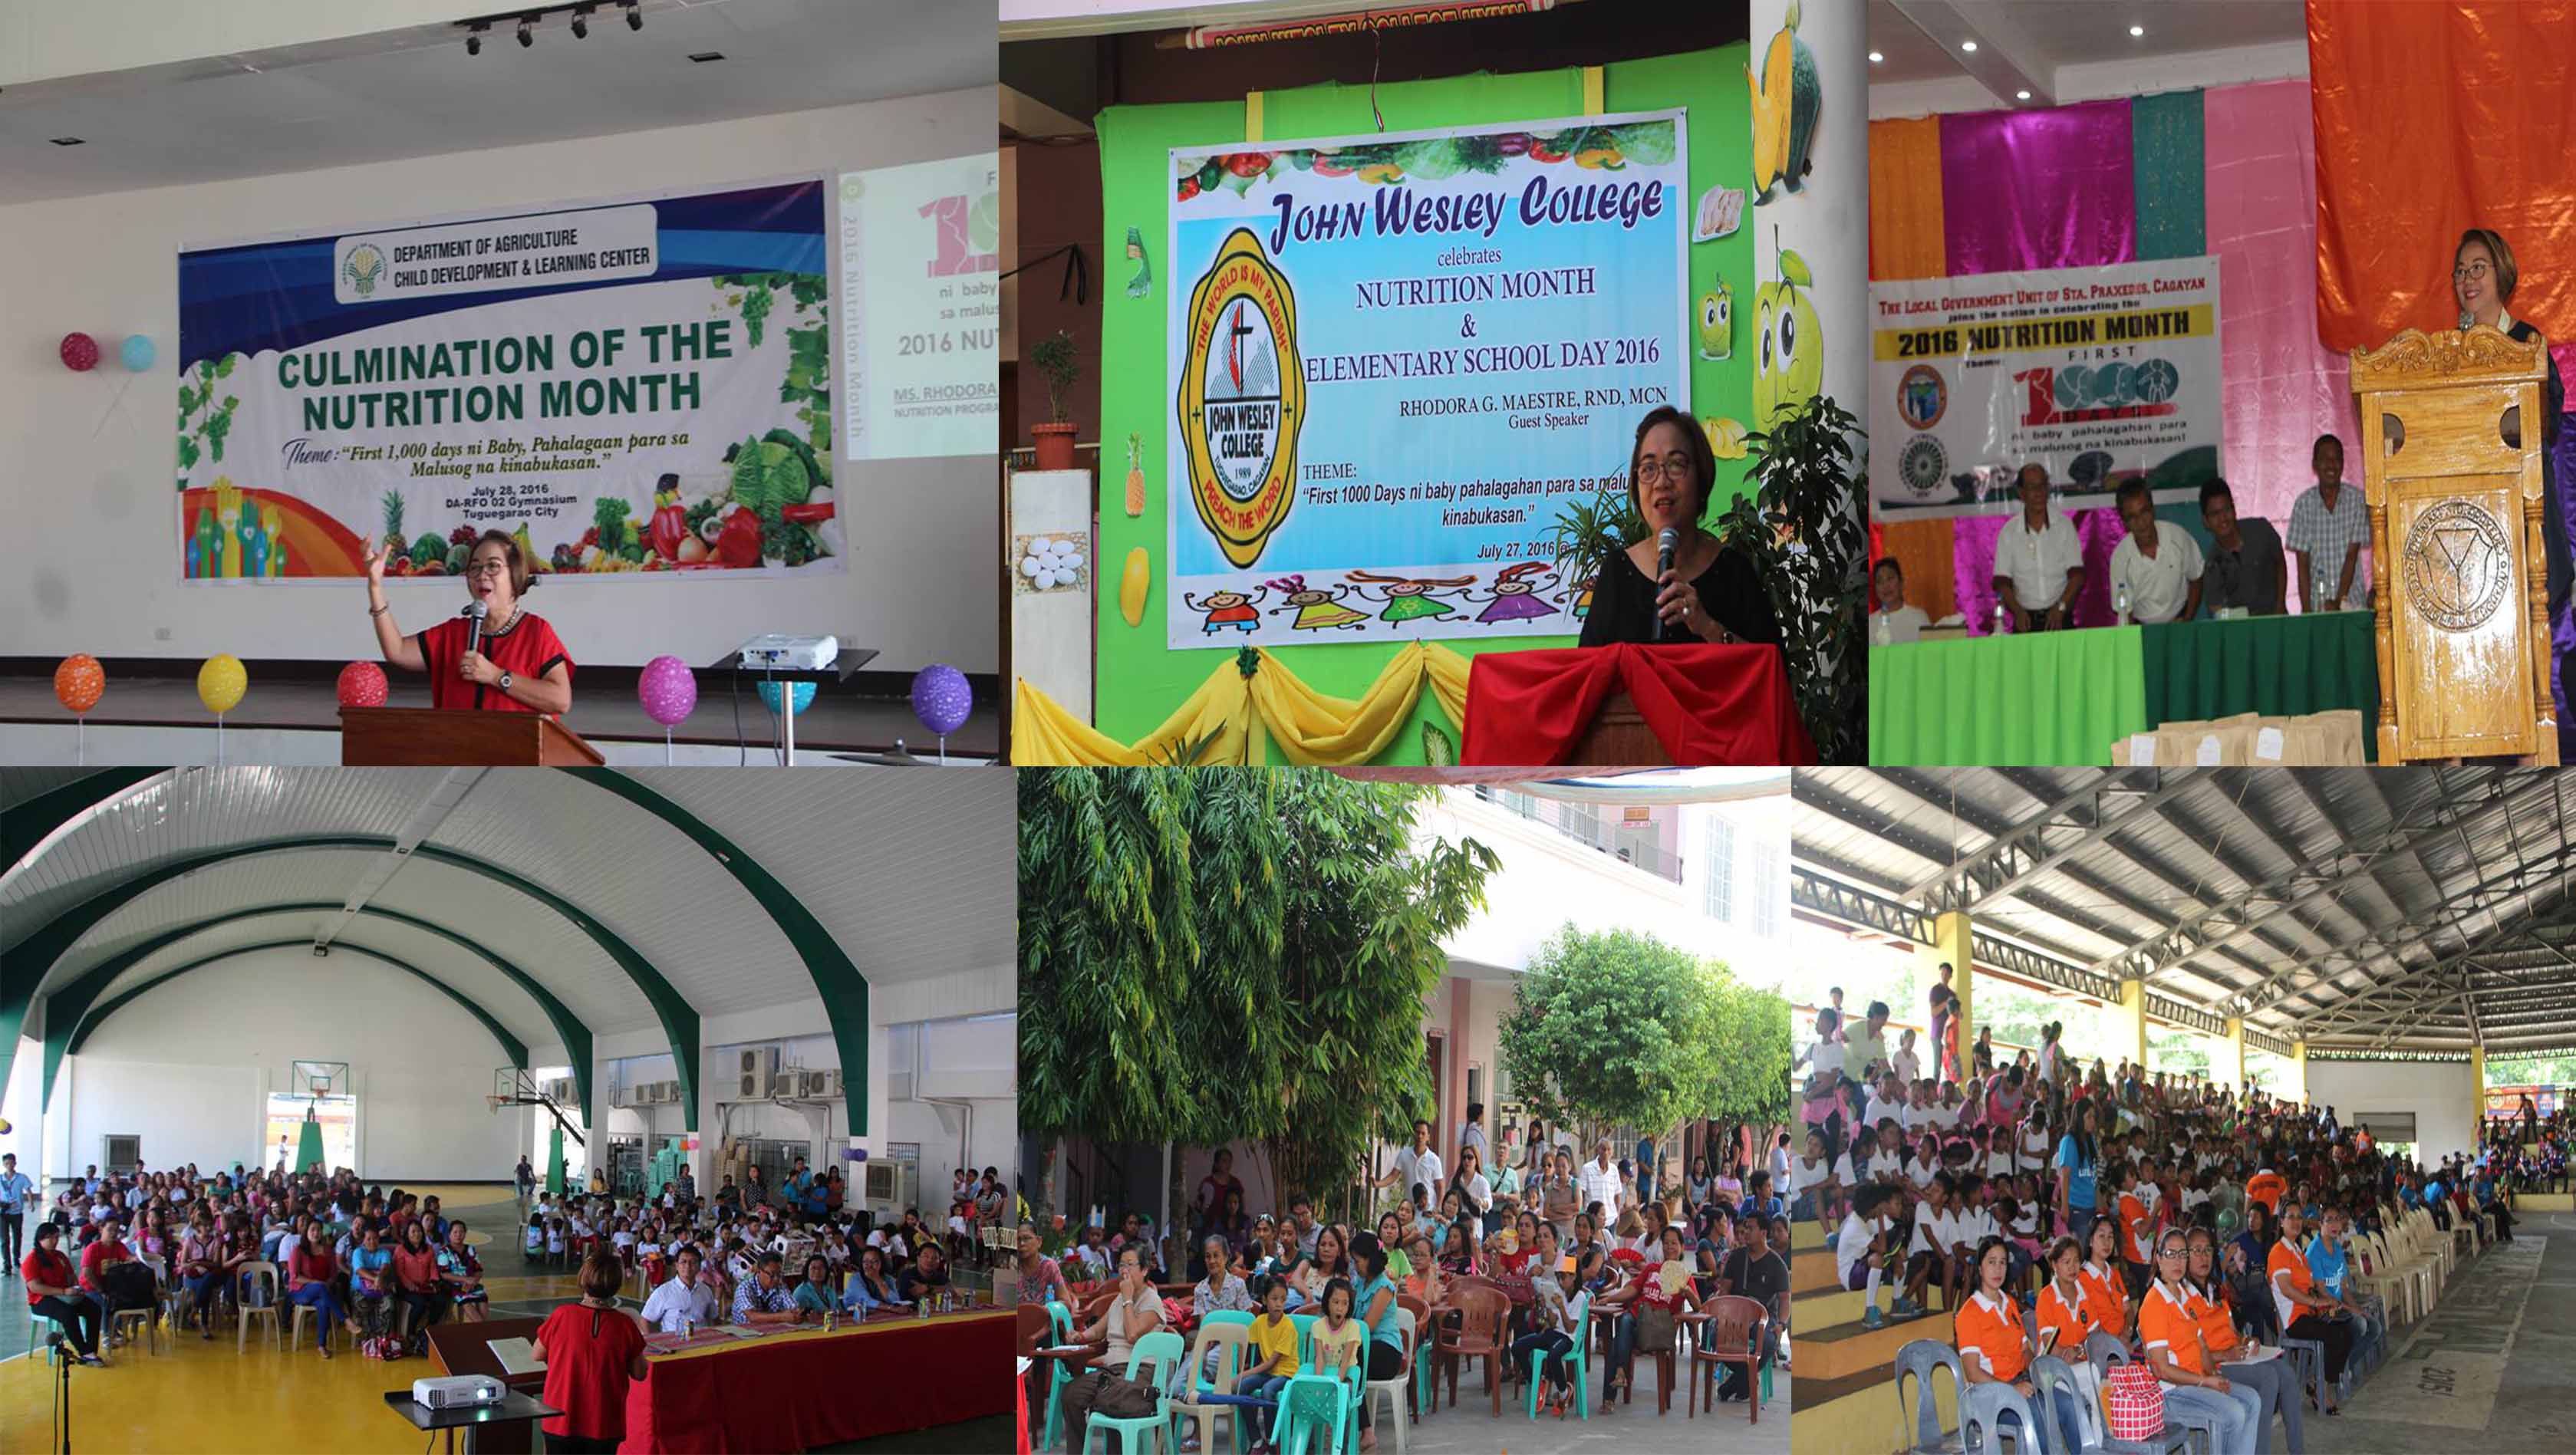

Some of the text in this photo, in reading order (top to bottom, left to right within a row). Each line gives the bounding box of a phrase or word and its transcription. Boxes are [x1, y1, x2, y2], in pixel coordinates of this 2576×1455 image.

[1270, 175, 1663, 255] JOHN WESLEY COLLEGE
[394, 229, 578, 264] DEPARTMENT OF AGRICULTURE
[1437, 246, 1501, 267] celebrates
[394, 247, 650, 288] CHILD DEVELOPMENT & LEARNING CENTER
[1207, 267, 1238, 315] WORLD
[1241, 265, 1248, 281] IS
[1251, 266, 1266, 292] MY
[1356, 268, 1596, 308] NUTRITION MONTH
[1905, 300, 1938, 314] LOCAL
[1942, 293, 2014, 311] GOVERNMENT
[2017, 290, 2042, 304] UNIT
[2153, 278, 2205, 294] CAGAYAN
[845, 216, 864, 438] 2016 Nutrition Month
[1461, 314, 1477, 337] &
[1899, 311, 2189, 357] 2016 NUTRITION MONTH
[278, 320, 732, 389] CULMINATION OF THE
[899, 328, 999, 356] 2016 NU
[2068, 346, 2136, 360] FIRST
[1306, 337, 1659, 383] ELEMENTARY SCHOOL DAY 2016
[304, 372, 700, 432] NUTRITION MONTH
[923, 382, 996, 400] RHODORA
[1400, 387, 1668, 417] RHODORA G. MAESTRE, RND, MCN
[1209, 403, 1276, 441] JOHN WESLEY
[1508, 412, 1589, 430] Guest Speaker
[2033, 429, 2063, 441] baby
[2071, 424, 2152, 438] pahalagahan
[2159, 420, 2186, 433] para
[388, 443, 427, 462] 1,000
[431, 442, 463, 462] days
[468, 440, 483, 455] ni
[487, 439, 526, 457] Baby,
[532, 435, 623, 455] Pahalagaan
[628, 433, 666, 453] para
[671, 433, 689, 446] sa
[1221, 433, 1264, 459] COLLEGE
[2030, 440, 2083, 454] malusog
[2086, 440, 2100, 449] na
[410, 462, 471, 479] Malusog
[476, 462, 494, 473] na
[1235, 468, 1251, 479] 1989
[1249, 453, 1271, 492] CAGAYAN
[1303, 463, 1357, 480] THEME:
[446, 495, 578, 508] DA-RFO 02 Gymnasium
[472, 484, 548, 497] July 28, 2016
[1204, 476, 1281, 530] PREACH THE WORD
[1342, 485, 1371, 503] 1000
[1374, 484, 1405, 505] Days
[1410, 482, 1421, 500] ni
[1425, 481, 1457, 502] baby
[1459, 477, 1542, 501] pahalagahan
[1546, 478, 1575, 498] para
[1580, 479, 1594, 492] sa
[1599, 472, 1631, 491] malu
[463, 507, 558, 521] Tuguegarao City
[1477, 544, 1502, 561] July
[1506, 542, 1523, 559] 27,
[1527, 542, 1554, 556] 2016
